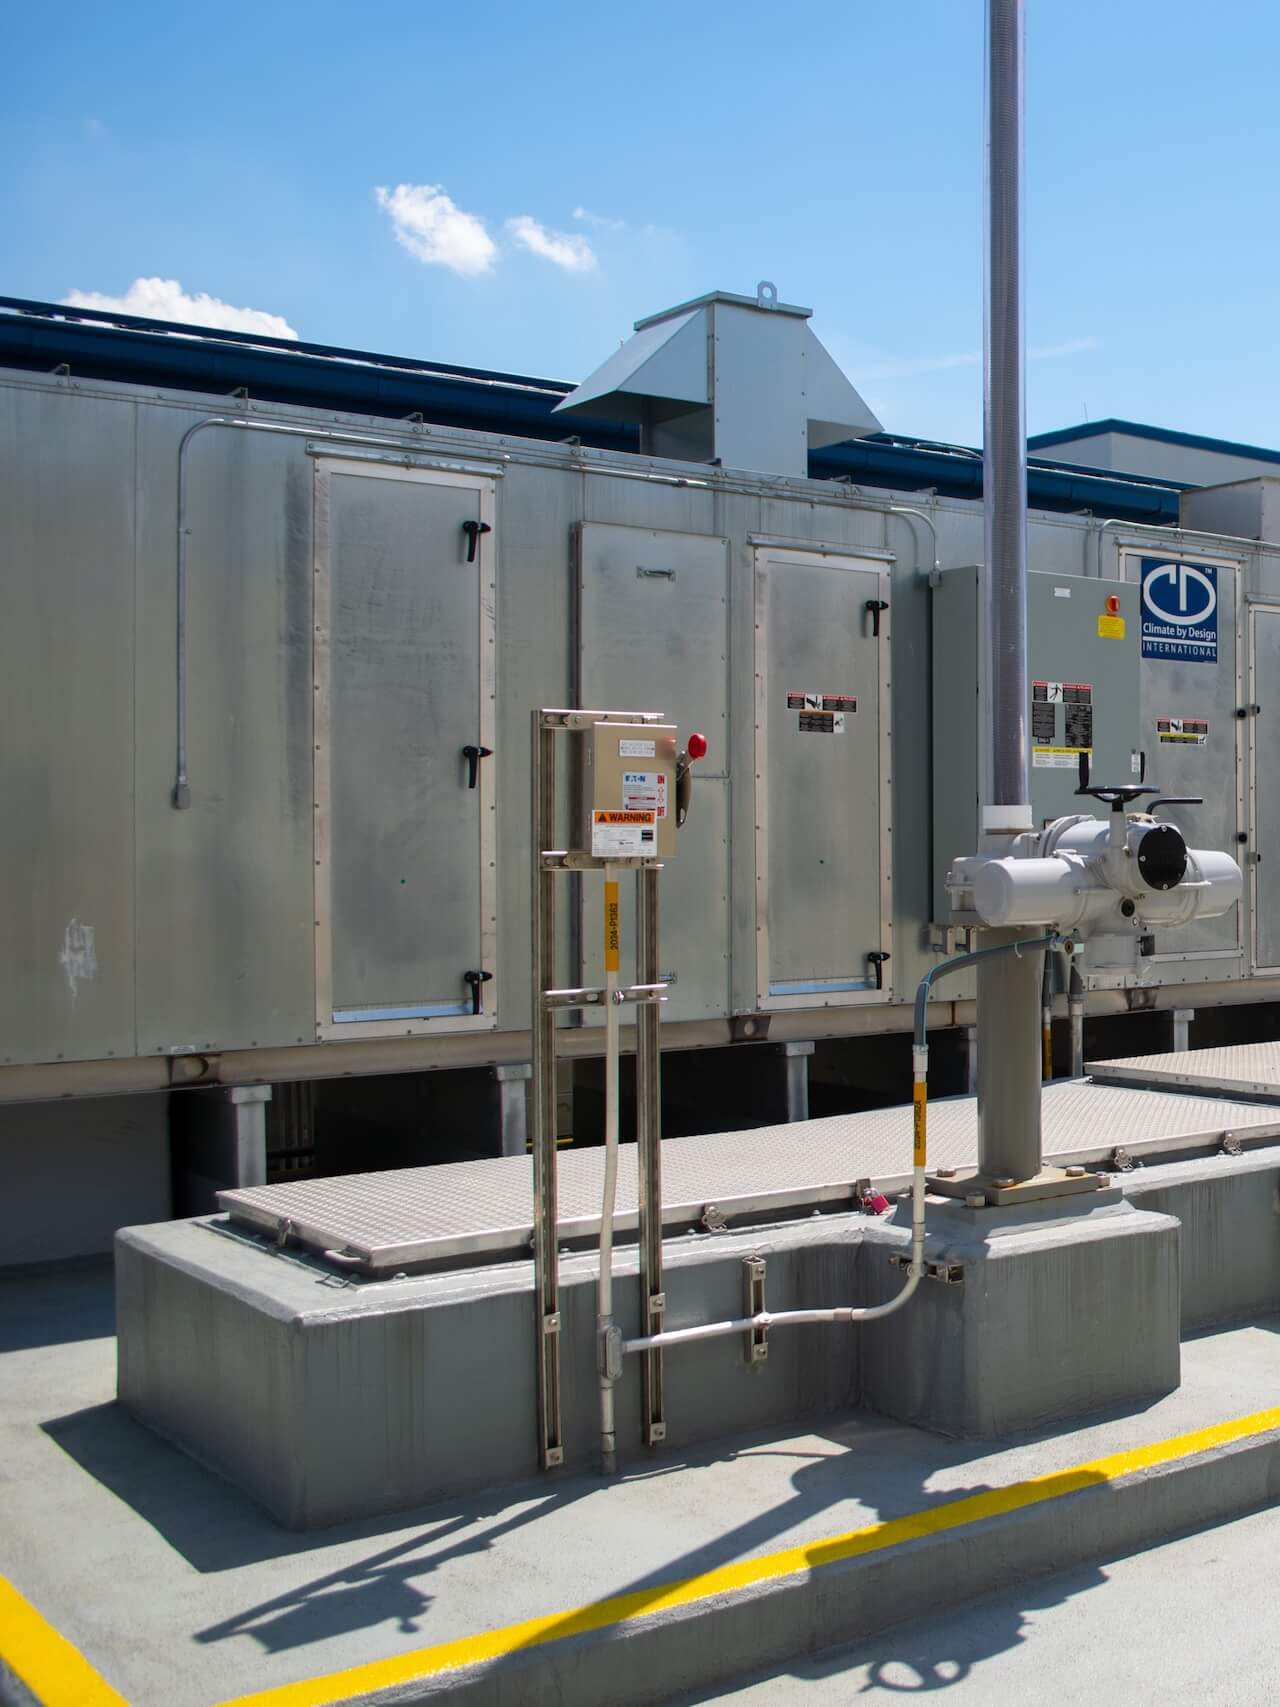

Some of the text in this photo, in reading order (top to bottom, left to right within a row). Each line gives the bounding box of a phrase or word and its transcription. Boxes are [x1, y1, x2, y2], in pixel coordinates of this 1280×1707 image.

[1143, 622, 1216, 640] Climate by Design
[1143, 641, 1216, 657] INTERNATIONAL
[609, 812, 651, 822] WARNING
